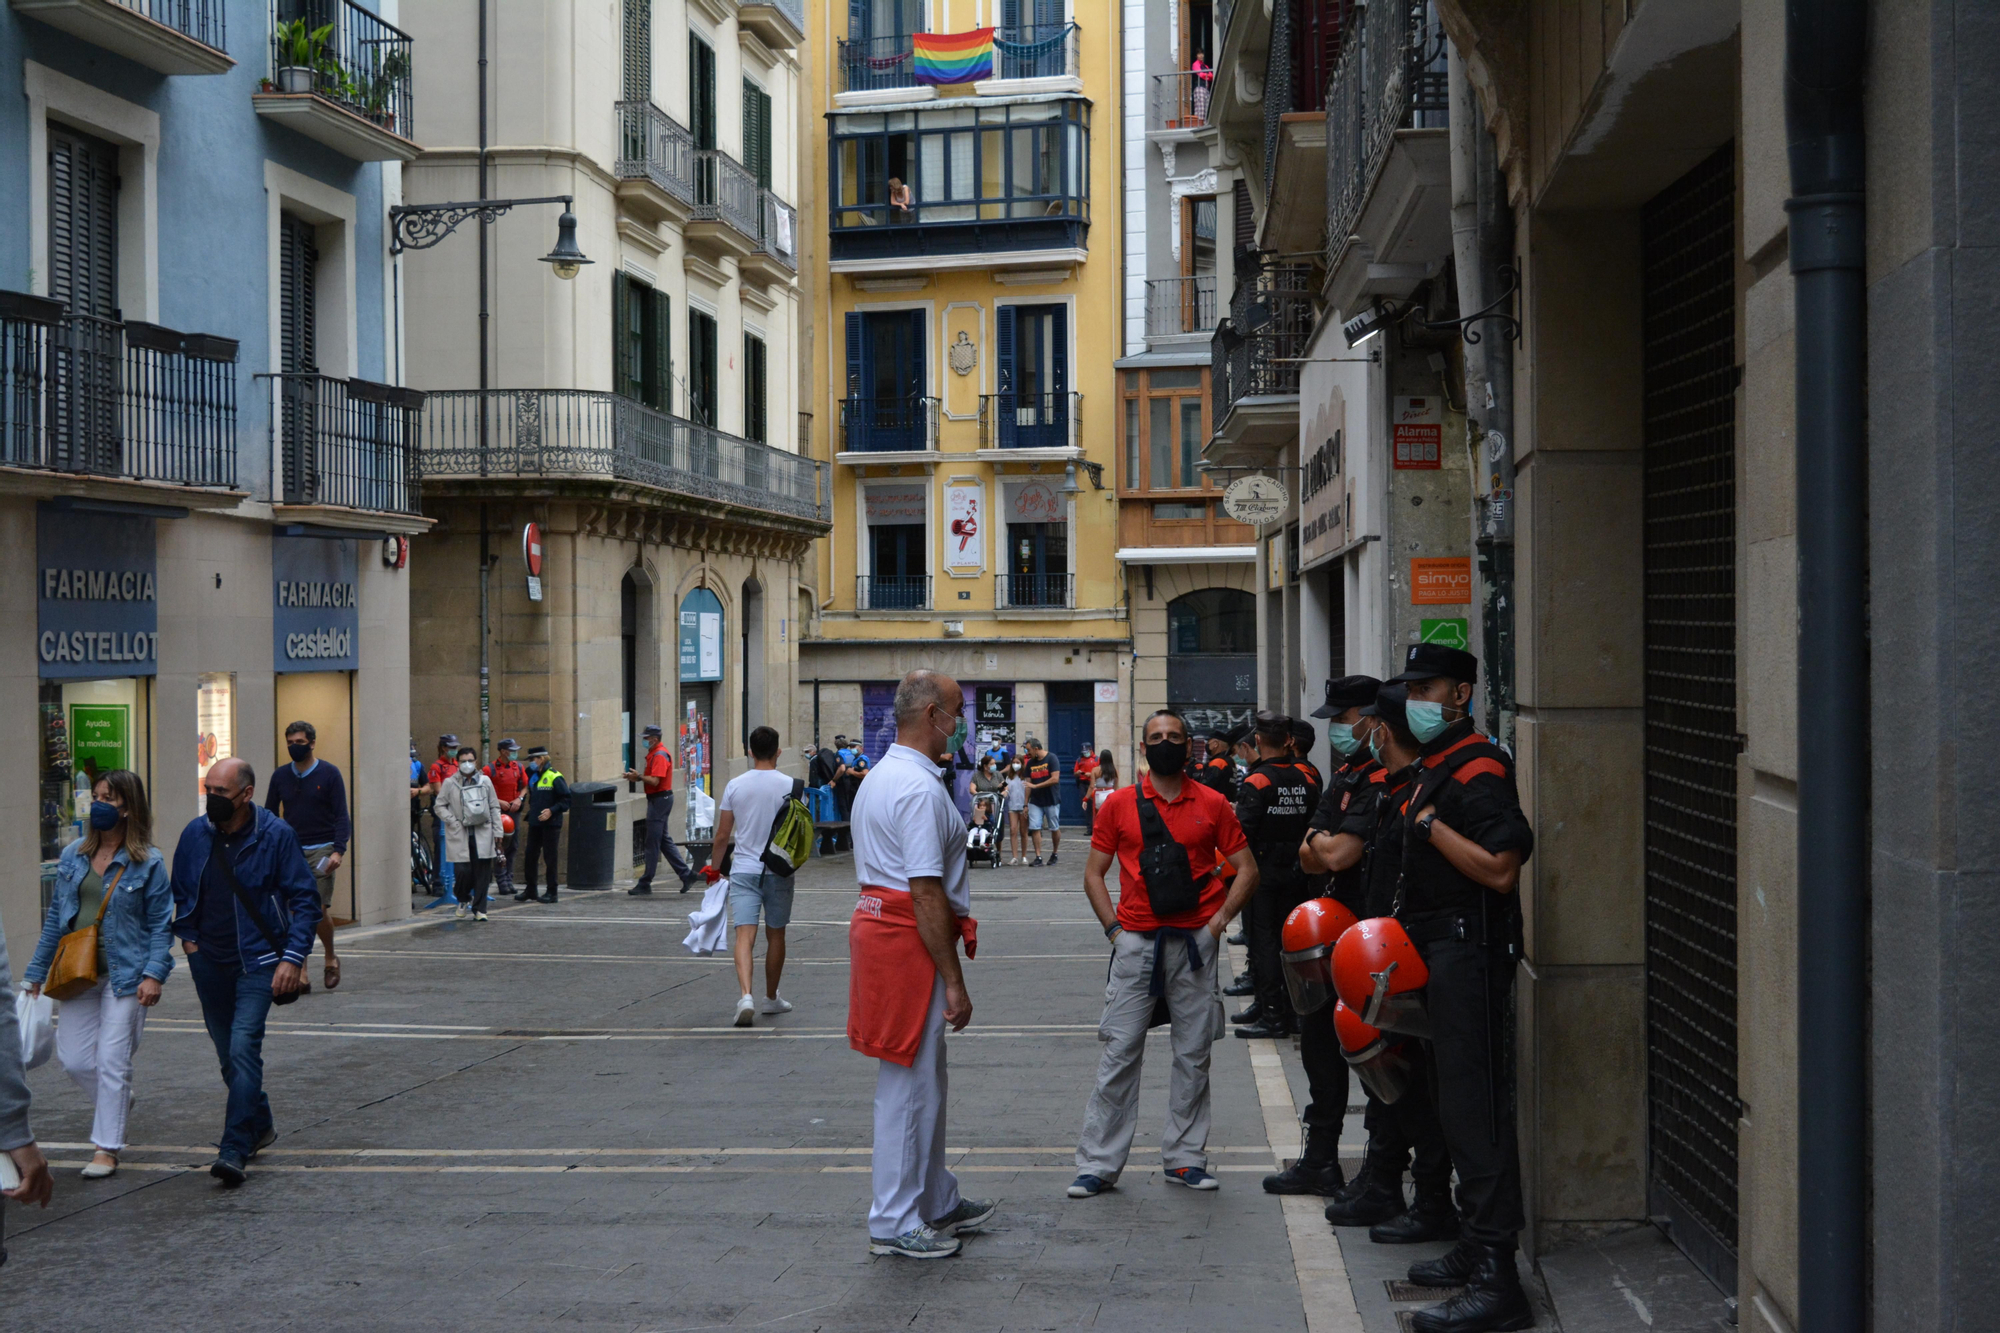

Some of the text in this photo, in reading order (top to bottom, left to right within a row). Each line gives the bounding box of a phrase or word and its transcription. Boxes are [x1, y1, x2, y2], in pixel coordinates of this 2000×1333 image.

[1397, 426, 1438, 437] Alarma
[1224, 480, 1244, 505] SELLOS
[1266, 477, 1289, 502] CAUCHO
[1236, 514, 1275, 525] RÓTULOS
[45, 568, 156, 601] FARMACIA
[1418, 572, 1469, 587] simyo
[279, 580, 357, 608] FARMACIA
[40, 630, 159, 662] CASTELLOT
[286, 627, 351, 658] castellot
[85, 719, 111, 729] Ayudas
[77, 740, 122, 748] la movilidad
